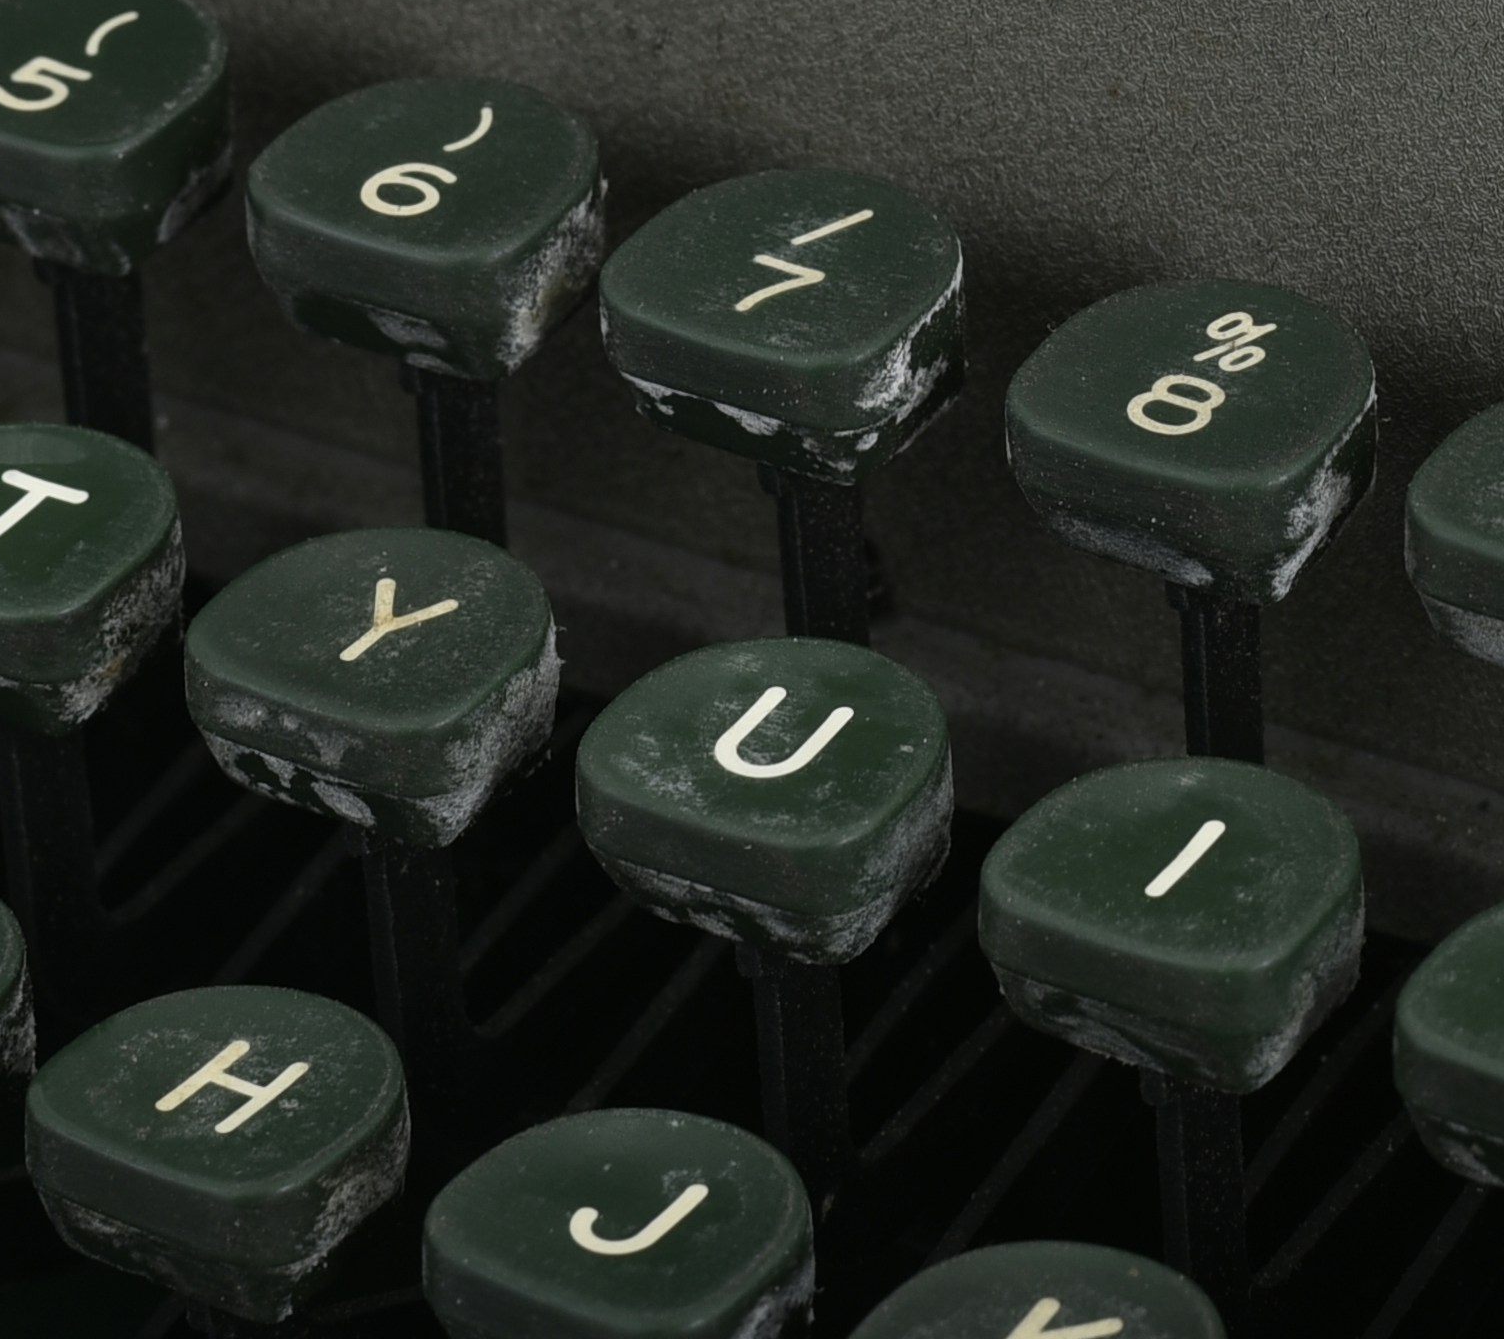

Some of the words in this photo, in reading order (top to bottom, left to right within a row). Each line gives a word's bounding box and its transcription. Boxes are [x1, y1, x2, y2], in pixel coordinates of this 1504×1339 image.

[359, 161, 459, 218] 6
[733, 253, 827, 313] 7
[1192, 310, 1278, 373] %
[1125, 372, 1227, 437] 8
[338, 576, 460, 663] Y
[712, 685, 856, 780] U
[1143, 818, 1227, 899] I
[154, 1038, 311, 1135] H
[568, 1182, 710, 1256] J
